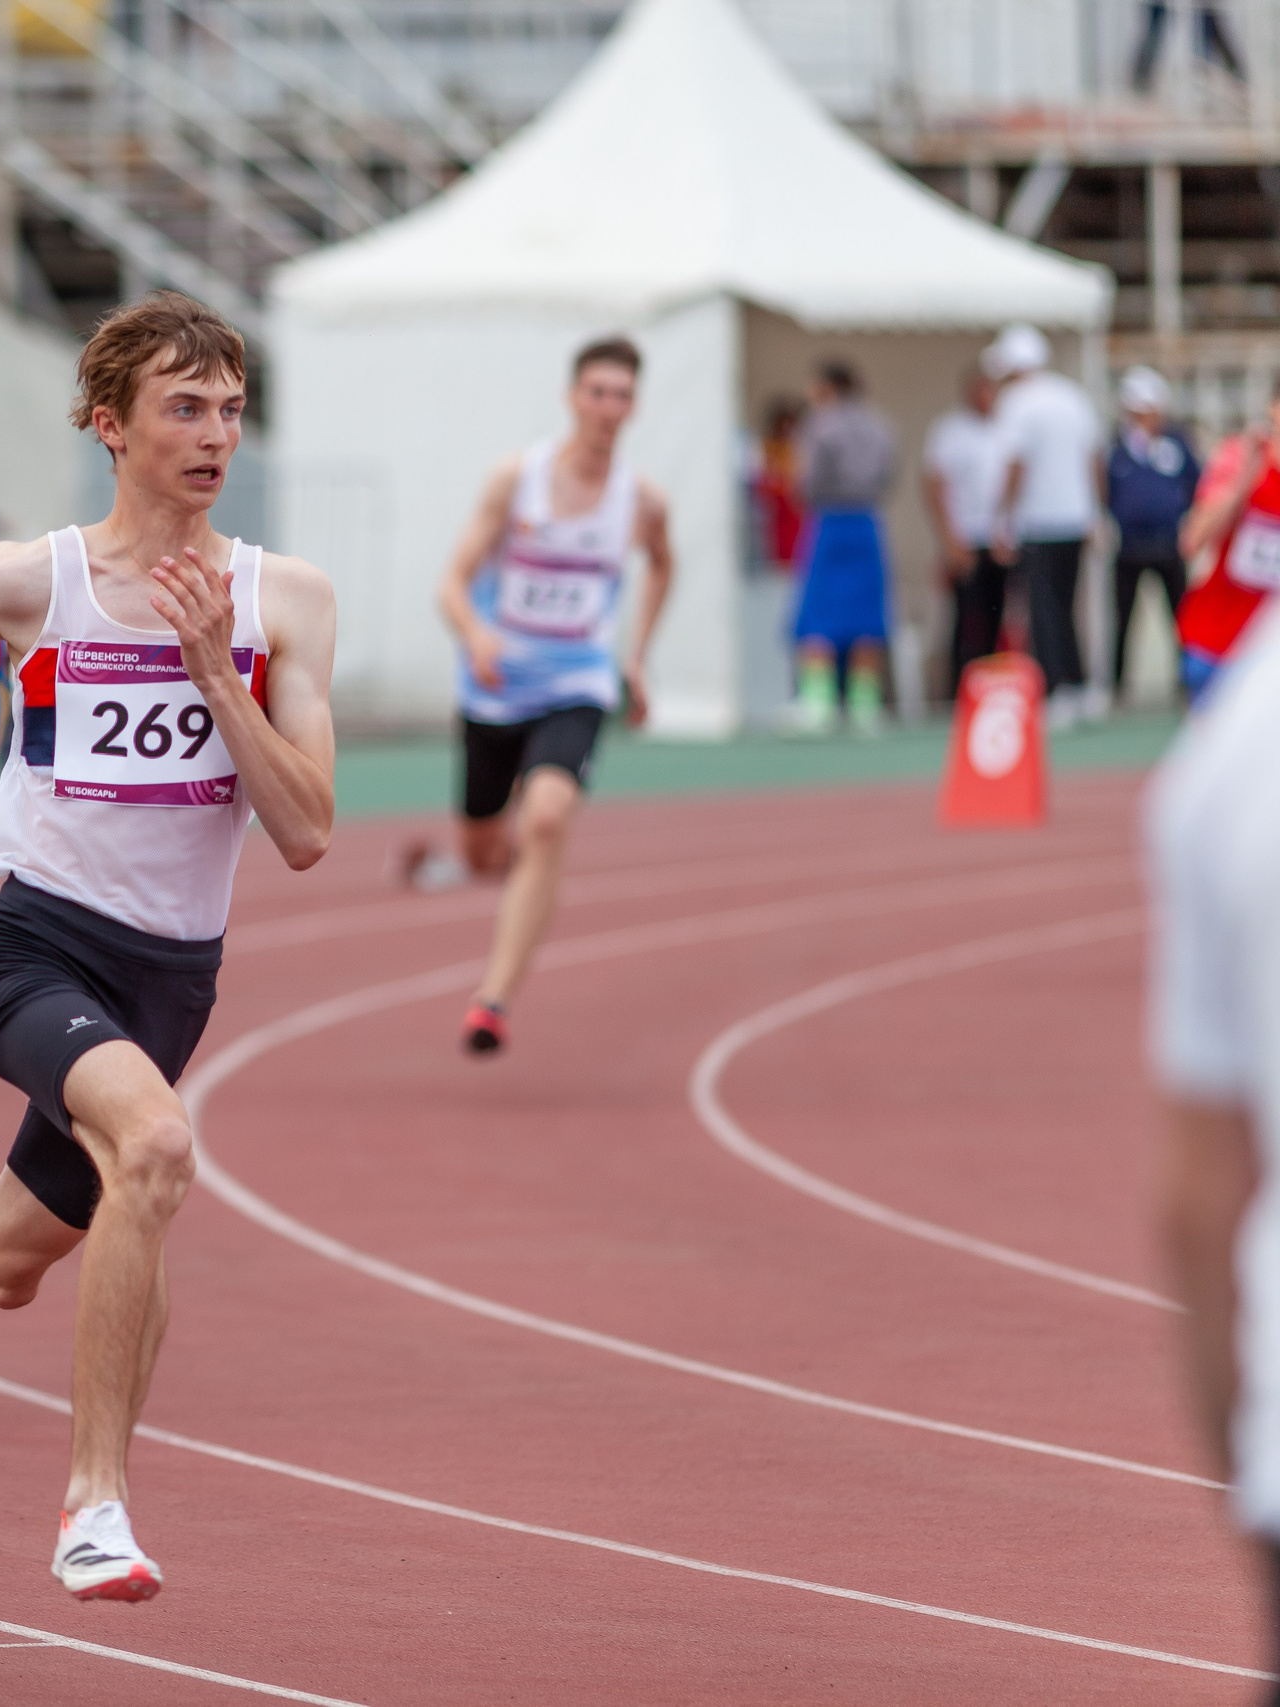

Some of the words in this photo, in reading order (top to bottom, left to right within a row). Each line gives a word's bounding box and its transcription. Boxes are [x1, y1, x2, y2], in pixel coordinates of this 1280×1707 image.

[70, 650, 139, 662] ПЕРВЕНСТВО
[69, 661, 133, 672] ПРИВОЛЖСКОГО
[91, 701, 214, 760] 269
[64, 785, 117, 799] ЧЕБОКСАРЫ
